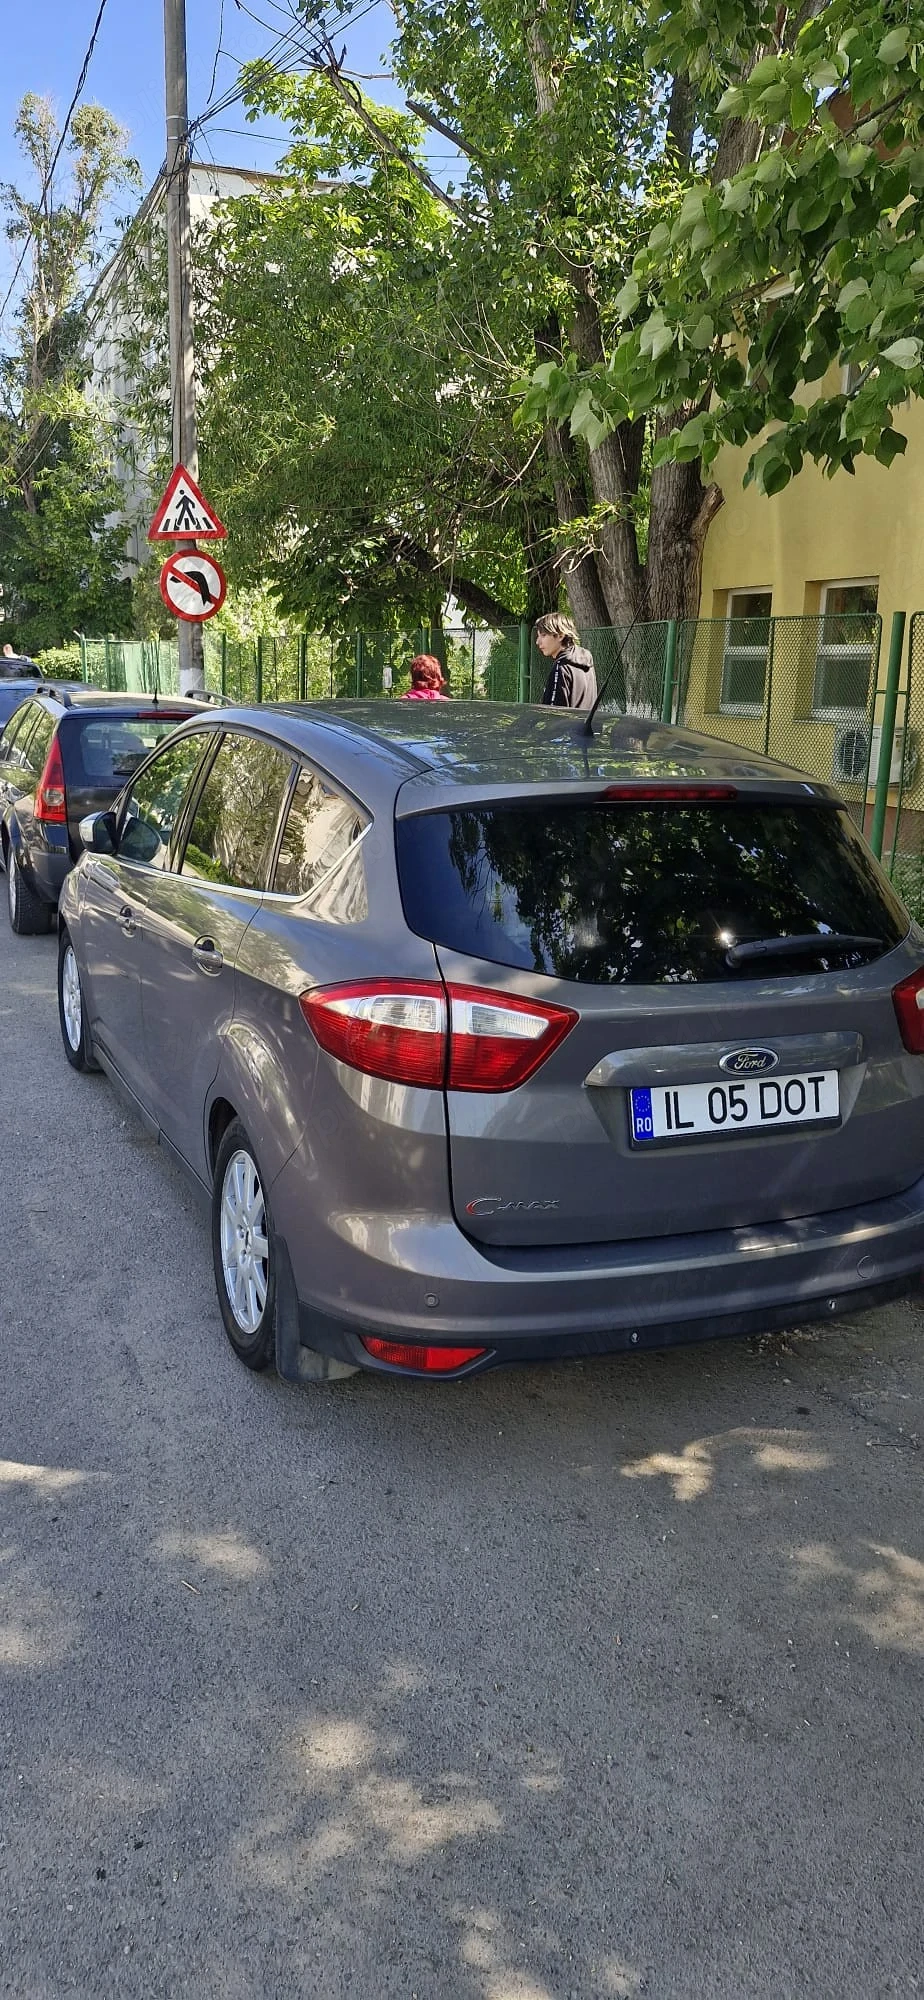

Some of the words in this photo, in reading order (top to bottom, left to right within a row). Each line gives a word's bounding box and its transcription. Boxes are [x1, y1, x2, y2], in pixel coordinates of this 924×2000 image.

[734, 1053, 767, 1070] Ford
[664, 1091, 694, 1130] IL
[707, 1085, 748, 1124] 05
[759, 1076, 825, 1120] DOT
[636, 1117, 652, 1133] RO
